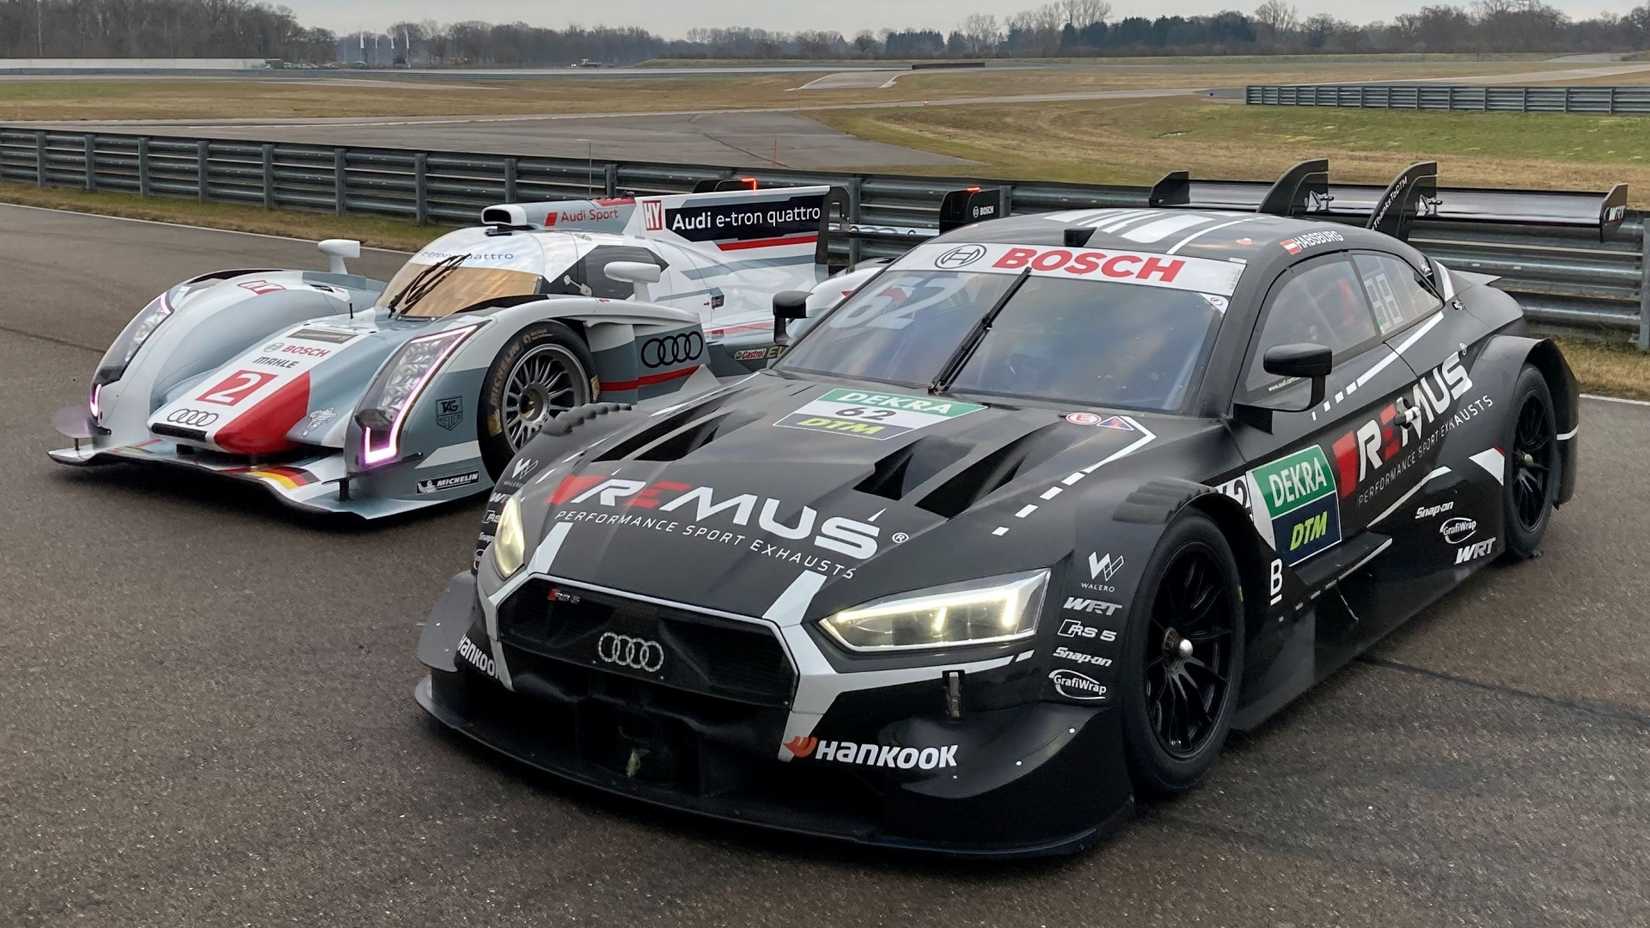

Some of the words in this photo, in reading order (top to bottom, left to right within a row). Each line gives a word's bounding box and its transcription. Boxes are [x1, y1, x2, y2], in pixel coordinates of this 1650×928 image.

[561, 211, 586, 223] Audi
[589, 209, 618, 221] Sport
[643, 201, 663, 231] HY
[672, 212, 711, 230] Audi
[716, 211, 763, 228] e-tron
[767, 207, 821, 227] quattro
[980, 206, 994, 215] BOSCH
[1293, 230, 1344, 250] HABSBURG
[992, 248, 1185, 283] BOSCH
[282, 345, 331, 358] BOSCH
[253, 356, 299, 369] MAHLE
[205, 373, 263, 402] 2
[440, 400, 458, 412] TAG
[837, 391, 953, 414] DEKRA
[834, 407, 897, 421] 62
[1357, 351, 1473, 482] REMUS
[798, 418, 885, 434] DTM
[1358, 450, 1416, 505] PERFORMANCE
[1418, 431, 1440, 458] SPORT
[1440, 394, 1494, 439] EXHAUSTS
[437, 473, 479, 487] MICHELIN
[1268, 457, 1327, 507] DEKRA
[570, 479, 880, 560] REMUS
[1415, 501, 1454, 519] Snap-on
[1289, 511, 1328, 551] DTM
[1443, 520, 1477, 536] GrafiWrap
[554, 510, 678, 533] PERFORMANCE
[682, 525, 746, 546] SPORT
[749, 540, 857, 580] EXHAUSTS
[1455, 537, 1497, 565] WRT
[1081, 582, 1116, 593] WALERO
[1270, 558, 1283, 596] B
[1063, 597, 1123, 616] WRT
[1067, 623, 1098, 638] RS
[1100, 630, 1117, 642] 5
[1053, 646, 1113, 667] Snap-on
[1053, 674, 1107, 695] GrafiWrap
